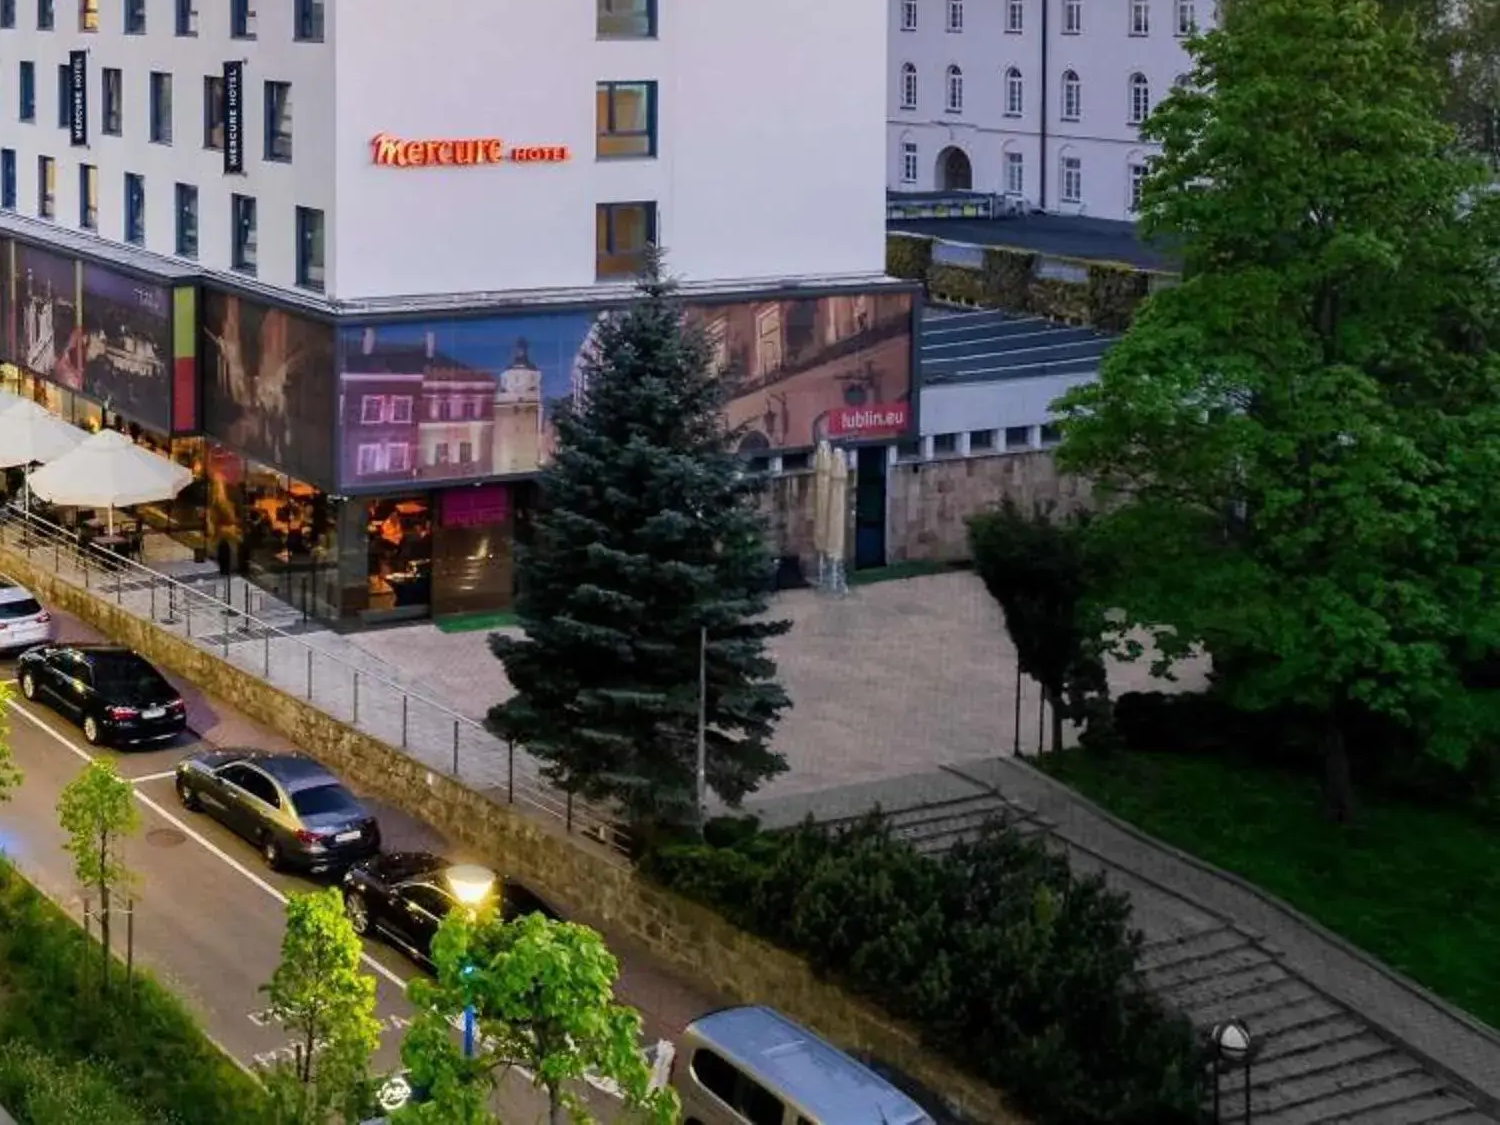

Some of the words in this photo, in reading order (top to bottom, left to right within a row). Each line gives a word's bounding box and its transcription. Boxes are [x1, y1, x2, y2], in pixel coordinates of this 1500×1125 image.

[74, 58, 82, 88] HOTEL
[229, 69, 237, 106] HOTEL
[75, 90, 83, 138] MERCURE
[229, 109, 238, 166] MERCURE
[841, 411, 904, 428] lublin.eu
